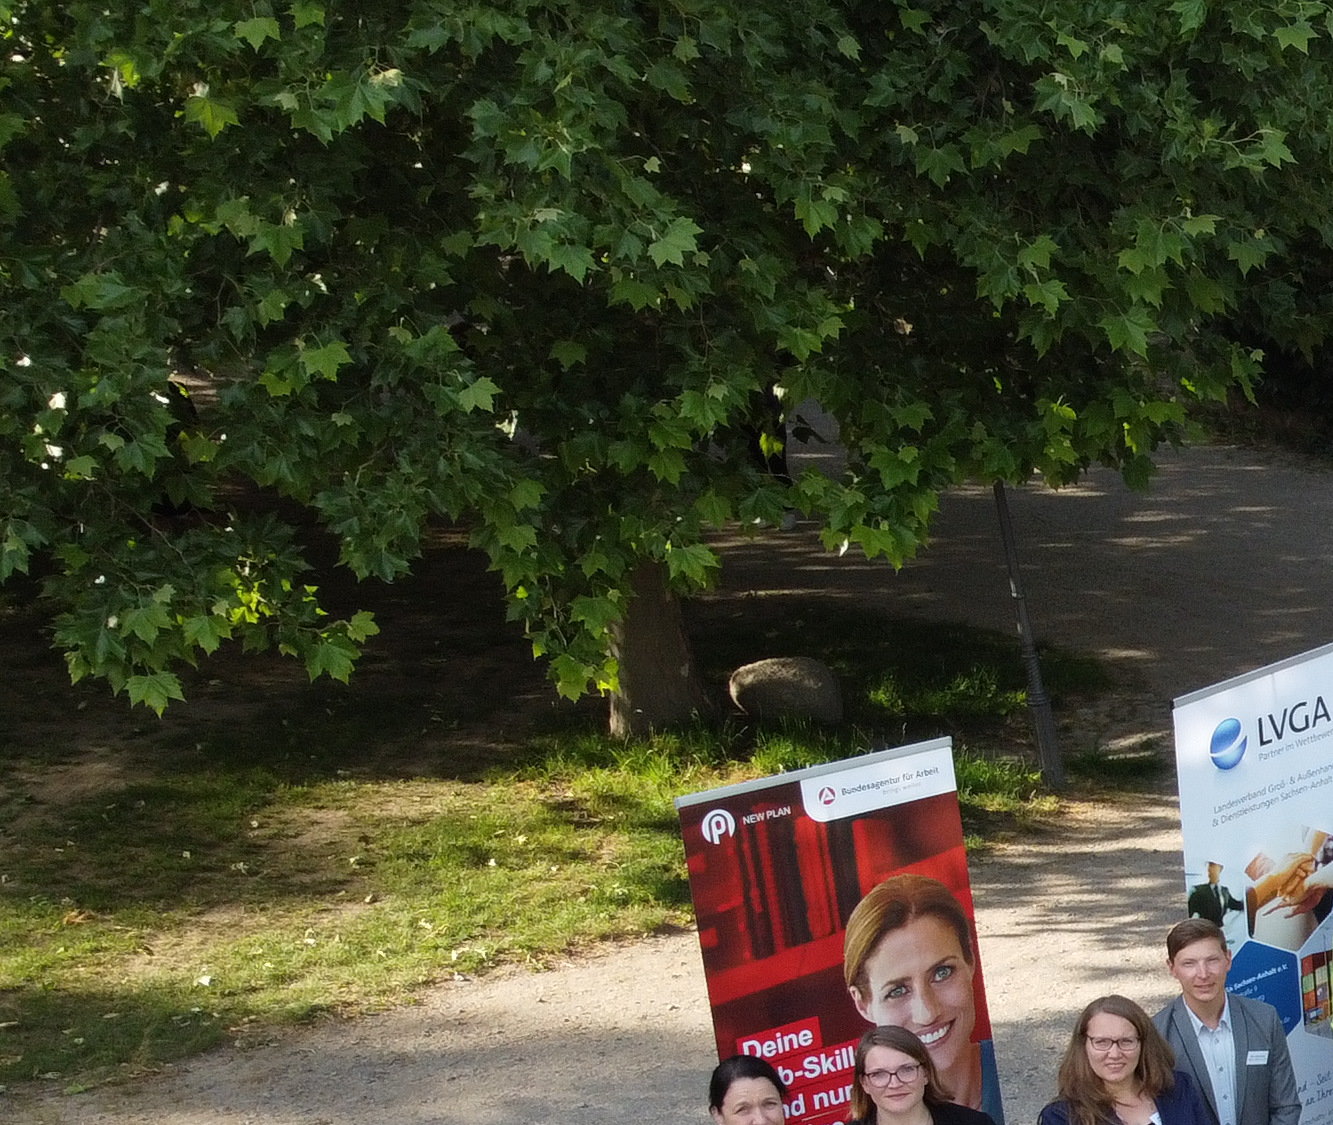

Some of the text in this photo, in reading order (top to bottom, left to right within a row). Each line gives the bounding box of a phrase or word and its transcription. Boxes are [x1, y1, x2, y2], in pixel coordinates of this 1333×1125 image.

[1258, 695, 1332, 747] LVGA
[841, 766, 940, 797] Bundesagentur für Arbeit
[742, 806, 792, 826] NEW PLAN
[742, 1029, 814, 1059] Deine
[778, 1045, 856, 1086] b-Skill
